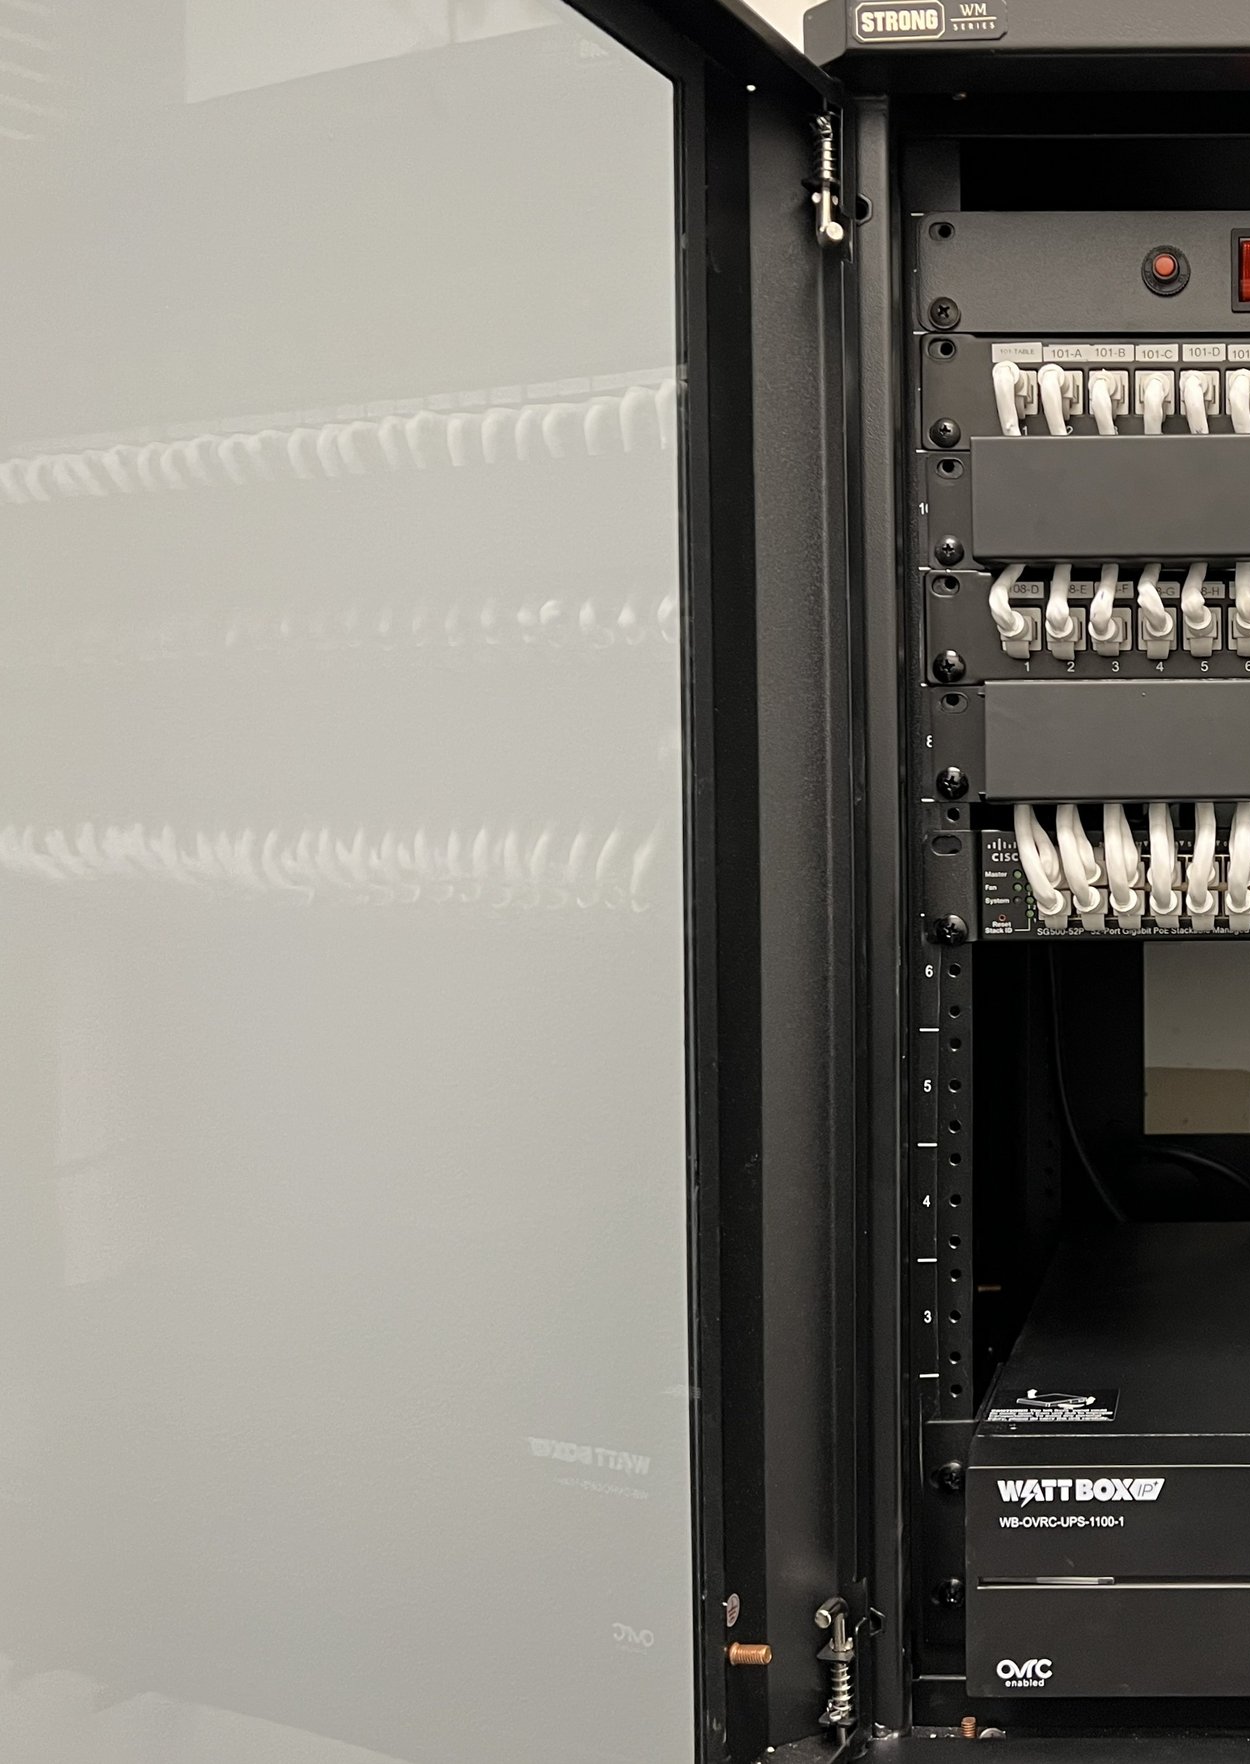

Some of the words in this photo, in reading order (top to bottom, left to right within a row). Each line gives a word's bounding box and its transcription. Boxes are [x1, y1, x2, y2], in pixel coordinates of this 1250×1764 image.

[959, 3, 987, 16] WM
[861, 9, 939, 33] STRONG
[952, 21, 996, 31] SERIES
[1051, 348, 1083, 359] 101-A
[1095, 347, 1126, 358] 101-B
[1142, 349, 1173, 360] 101-C
[1189, 346, 1221, 358] 101-D
[1023, 660, 1030, 672] 1
[1066, 660, 1076, 672] 2
[1111, 660, 1120, 673] 3
[1155, 661, 1165, 672] 4
[1200, 660, 1209, 672] 5
[991, 852, 1019, 862] CISC
[984, 897, 1010, 905] System
[925, 964, 934, 978] 6
[923, 1079, 932, 1093] 5
[922, 1194, 931, 1208] 4
[923, 1309, 932, 1324] 3
[999, 1515, 1124, 1528] WB-OVRC-UPS-1100-1
[1005, 1679, 1045, 1687] enabled
